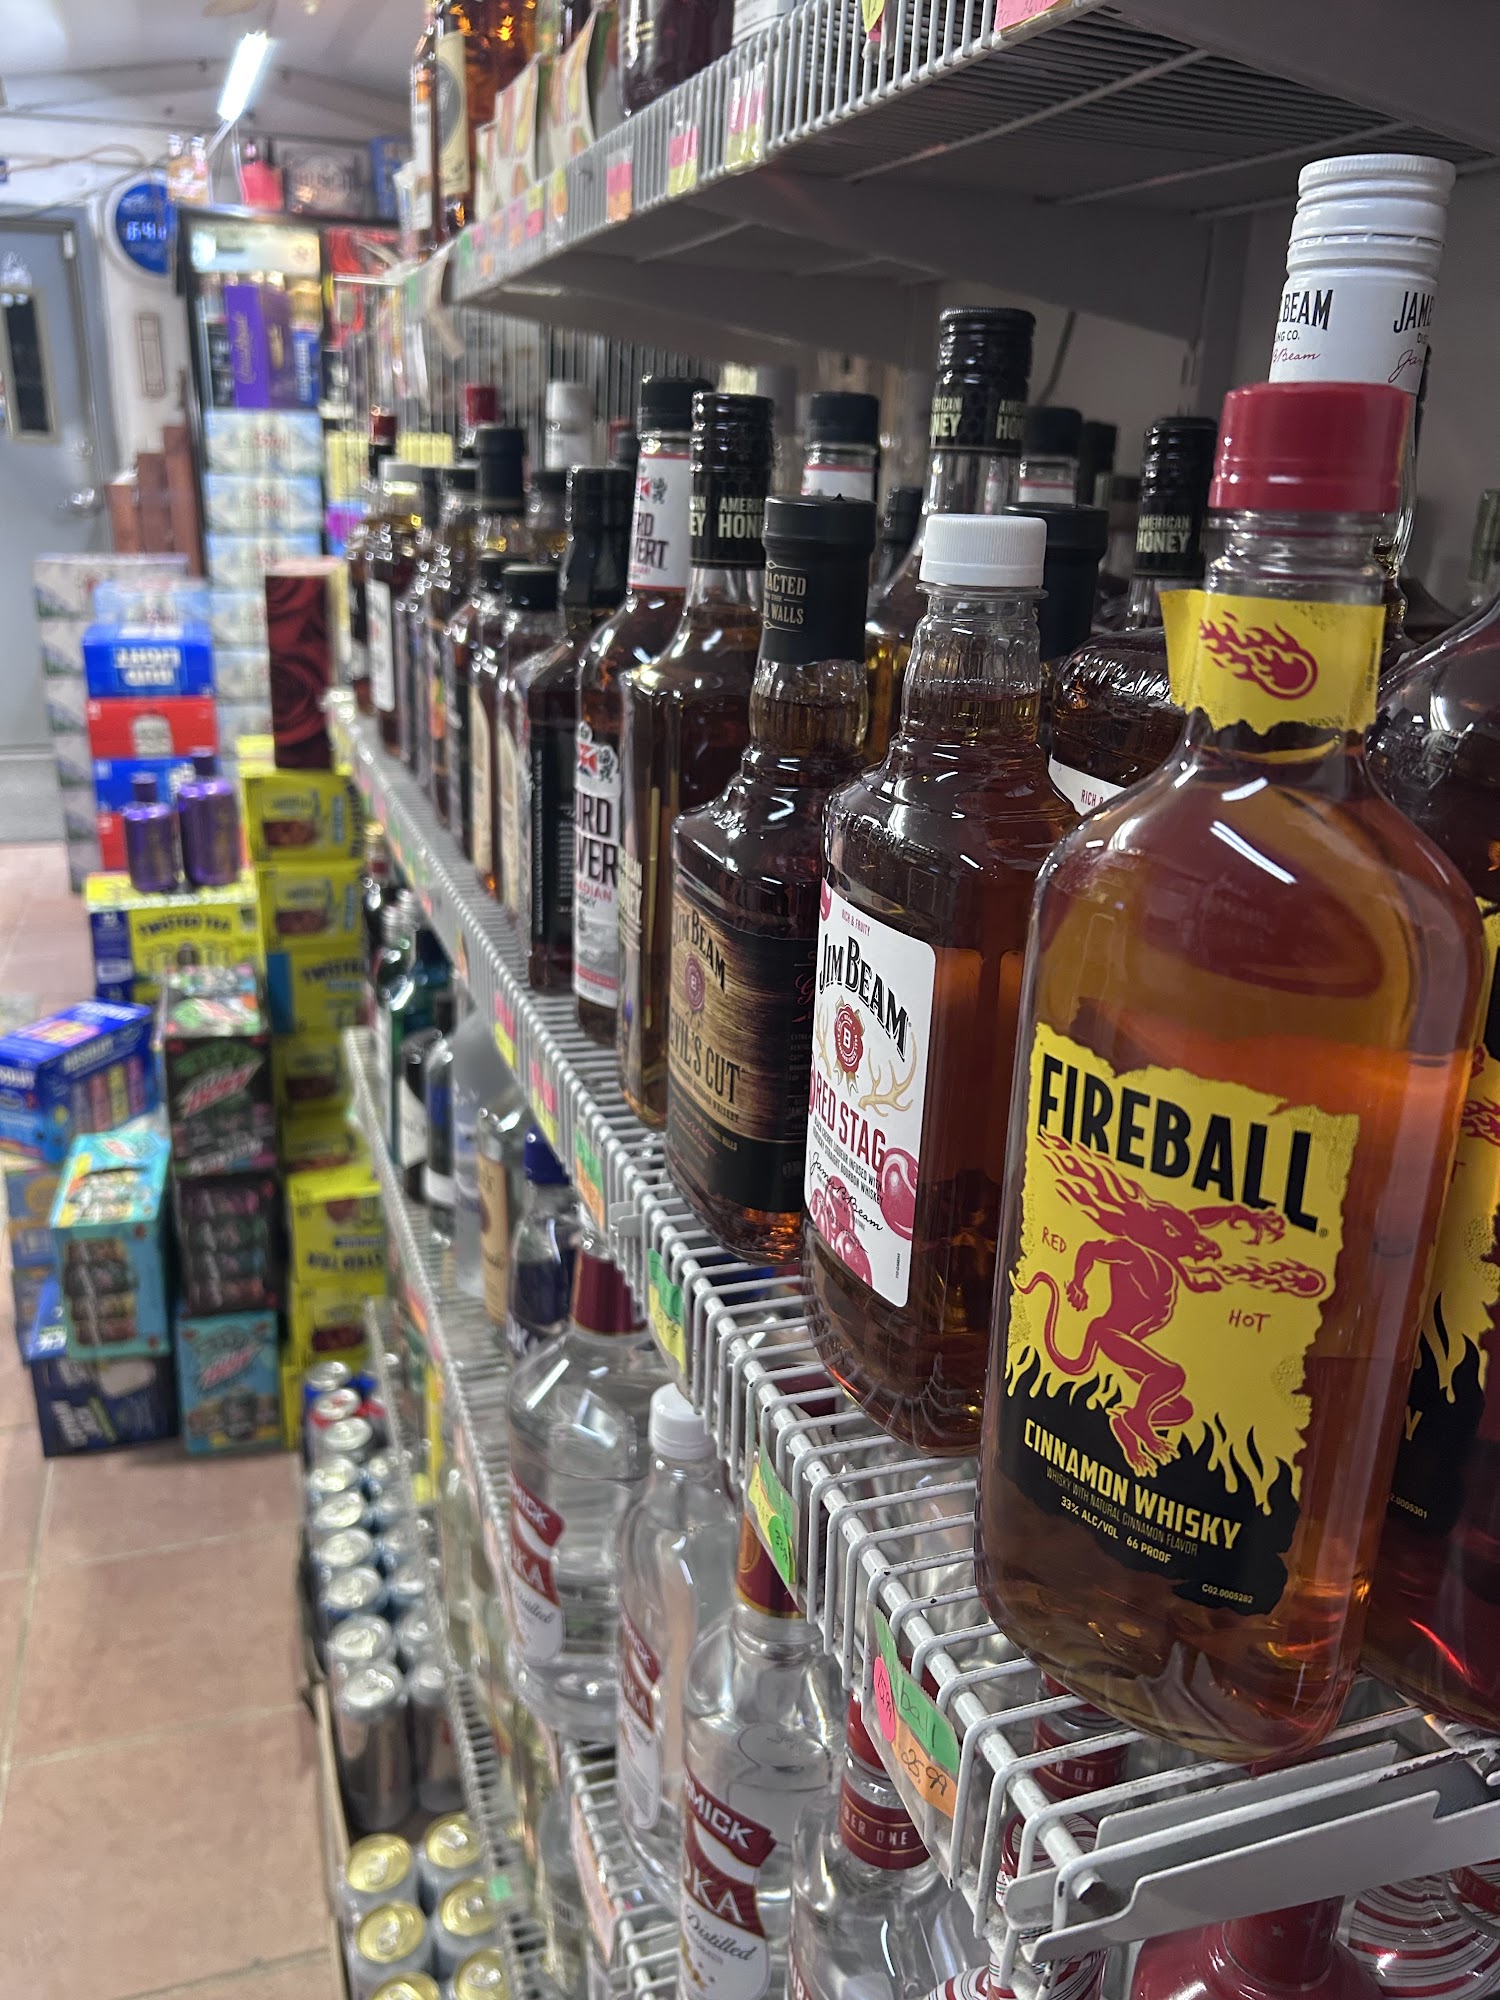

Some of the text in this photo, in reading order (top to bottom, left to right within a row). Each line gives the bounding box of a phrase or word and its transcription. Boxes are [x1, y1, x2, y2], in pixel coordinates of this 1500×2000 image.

[1282, 289, 1334, 331] BEAM
[1393, 291, 1434, 333] JAME
[1388, 350, 1423, 384] Ja
[930, 413, 962, 437] NEY
[719, 497, 765, 512] AMERI
[1136, 530, 1191, 553] HONEY
[765, 571, 807, 596] ACTED
[771, 604, 804, 624] WALLS
[579, 793, 612, 837] RD
[1081, 789, 1097, 806] RICH
[577, 835, 617, 889] VER
[691, 908, 727, 994] BEAM
[819, 933, 844, 995] JIM
[845, 935, 909, 1062] BEAM
[669, 1006, 703, 1077] EVIL'S
[705, 1046, 742, 1105] CUT
[815, 1070, 837, 1131] RED
[838, 1100, 887, 1173] STAG
[1037, 1053, 1318, 1234] FIREBALL
[848, 1157, 868, 1181] INFUSED
[867, 1173, 883, 1192] WITH
[860, 1180, 884, 1206] WHISKEY
[1042, 1226, 1067, 1253] RED
[1229, 1309, 1271, 1333] HOT
[1024, 1418, 1242, 1550] CINNAMON WHISKY
[1046, 1467, 1198, 1557] WHISKY WITH NATURAL CINNAMON FLAVOR
[1060, 1495, 1119, 1540] 33% ALC/VOL
[1388, 1492, 1428, 1520] 2.0005301
[1126, 1535, 1172, 1564] 66 PROOF
[685, 1776, 754, 1849] MICK
[844, 1810, 867, 1837] BER
